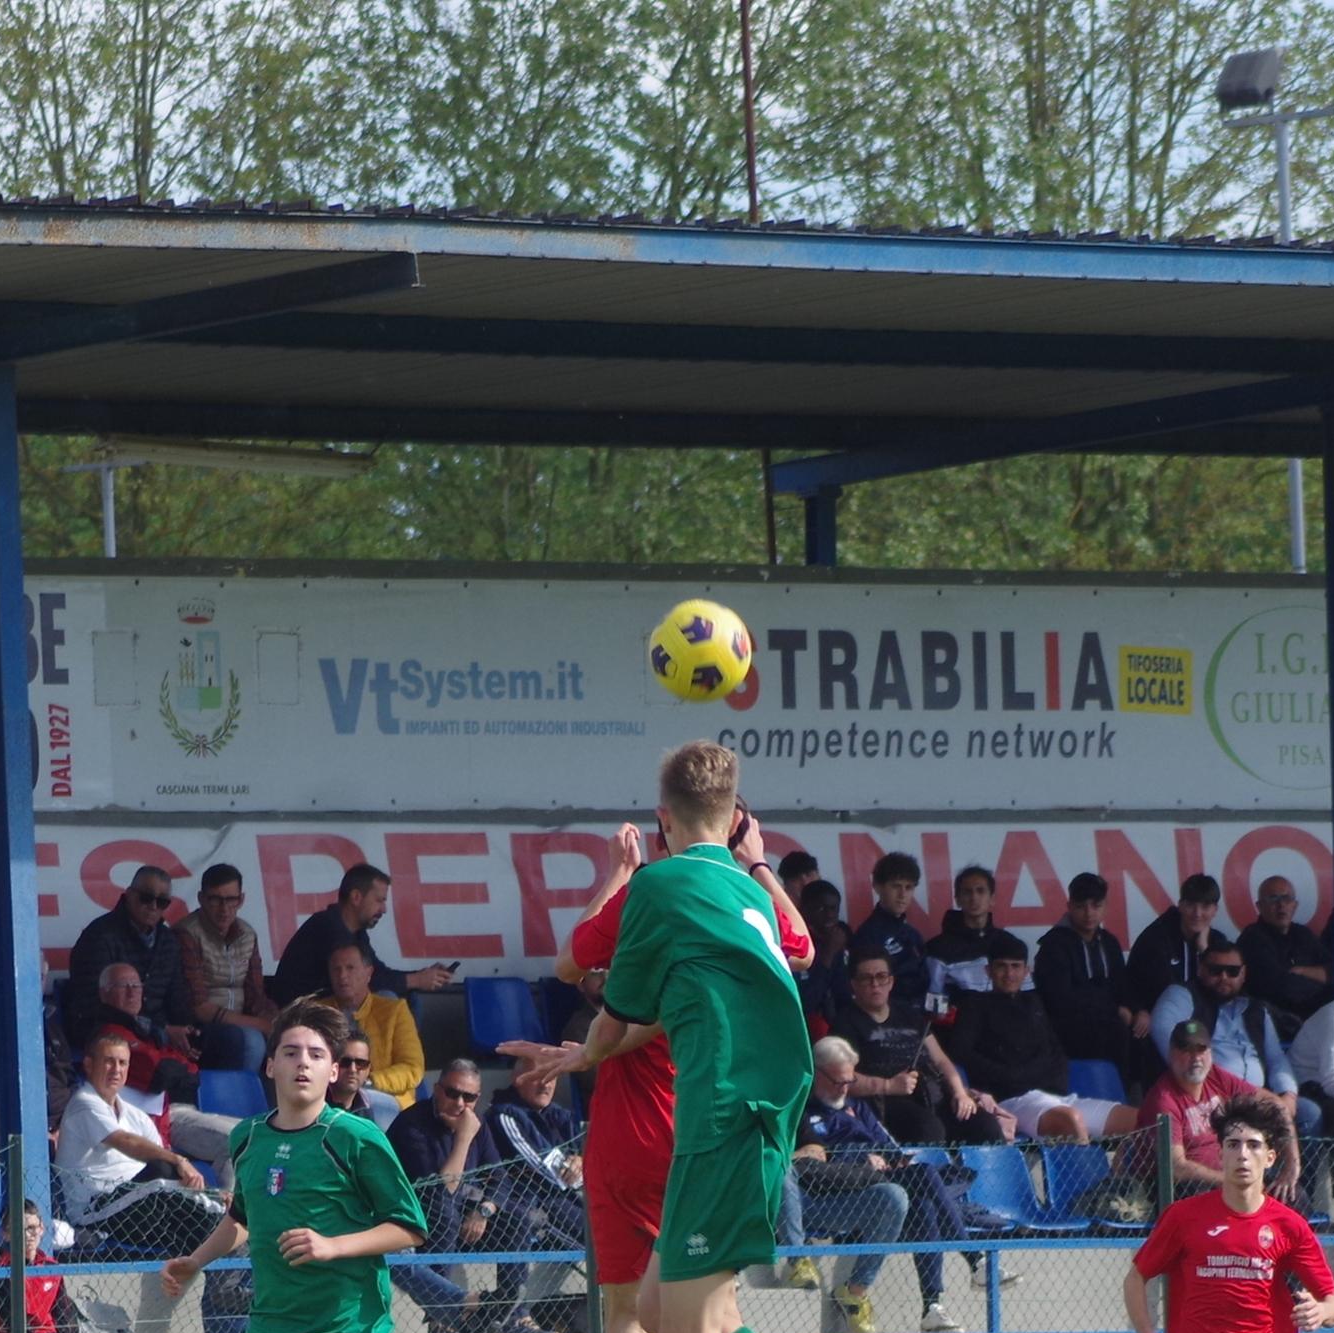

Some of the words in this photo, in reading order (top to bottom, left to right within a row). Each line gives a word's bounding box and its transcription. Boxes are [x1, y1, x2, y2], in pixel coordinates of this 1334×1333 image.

[1127, 653, 1183, 675] TIFOSERIA
[1127, 677, 1185, 707] LOCALE
[405, 720, 460, 735] IMPIANTI
[483, 720, 567, 736] AUTOMAZIONI
[570, 721, 646, 736] INDUSTRIALI
[719, 727, 949, 768] competence
[967, 722, 1117, 759] network
[1278, 745, 1325, 765] PISA
